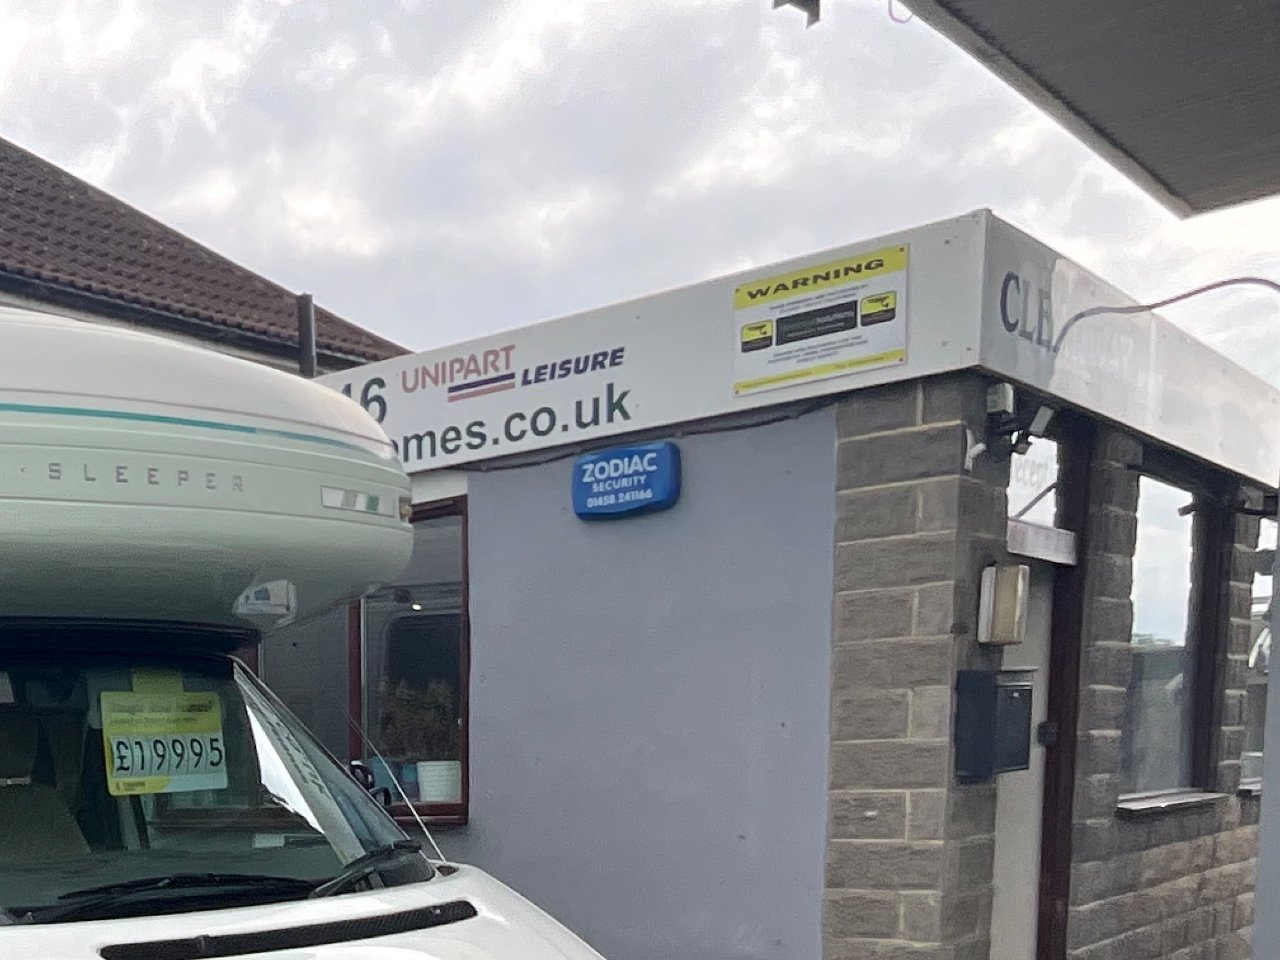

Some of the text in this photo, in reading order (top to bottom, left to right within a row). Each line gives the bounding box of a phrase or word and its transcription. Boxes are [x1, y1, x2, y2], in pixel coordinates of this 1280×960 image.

[747, 258, 885, 300] WARNING
[401, 344, 626, 394] UNIPART LEISURE
[391, 382, 632, 463] mes.co.uk
[582, 452, 658, 483] ZODIAC
[592, 474, 647, 493] SECURITY
[116, 738, 224, 771] £19995
